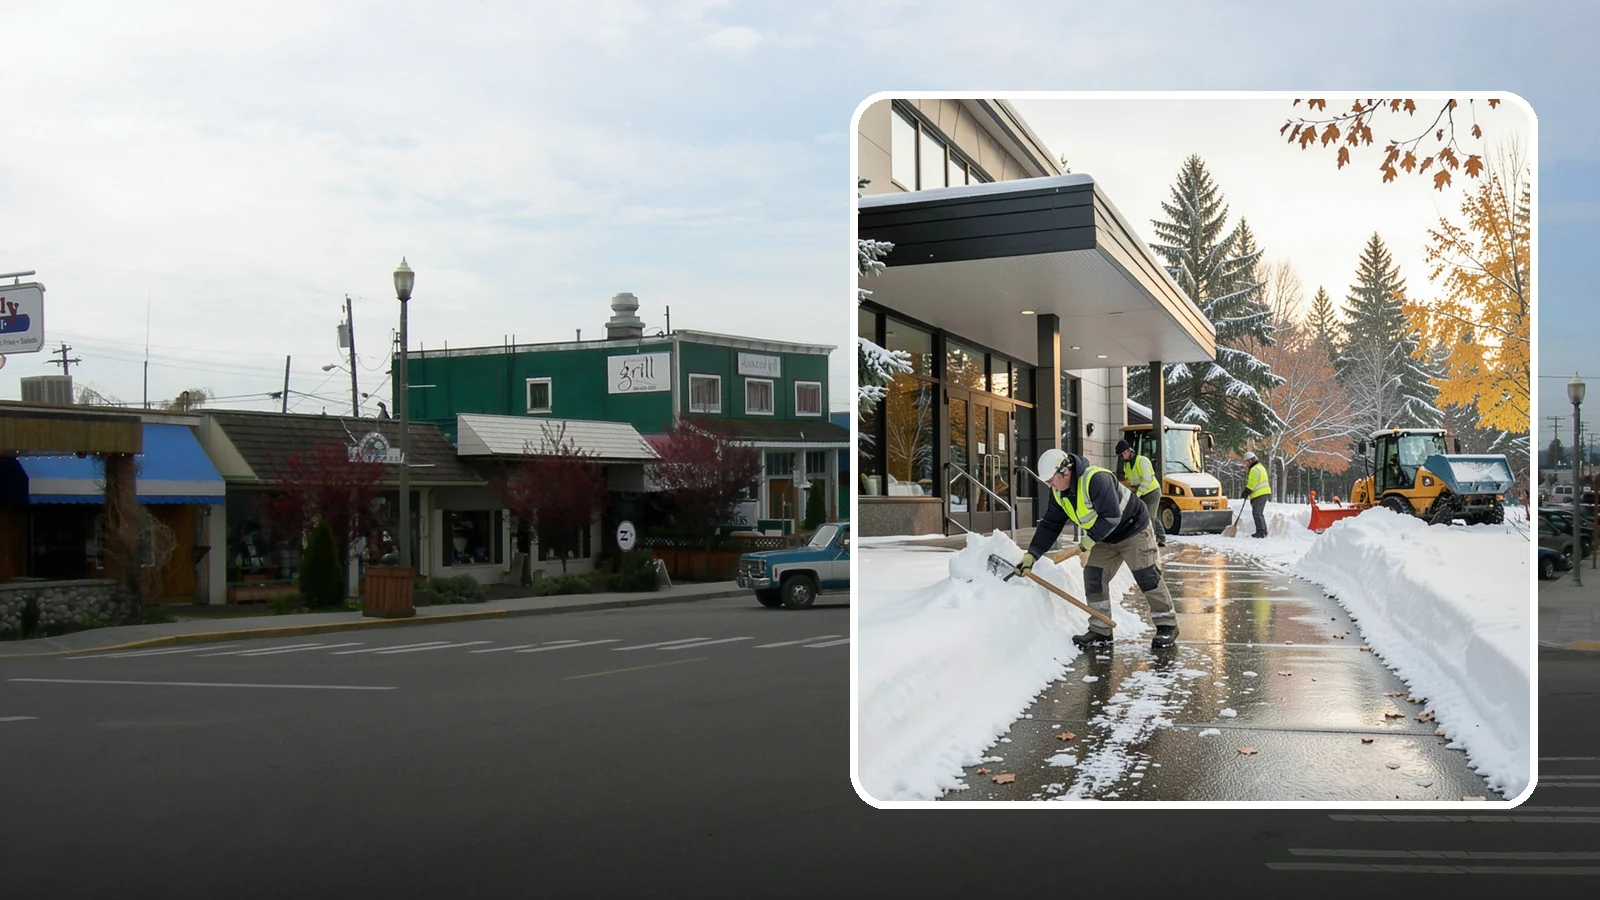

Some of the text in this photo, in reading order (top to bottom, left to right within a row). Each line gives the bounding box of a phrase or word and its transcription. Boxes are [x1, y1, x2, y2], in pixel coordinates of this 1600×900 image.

[0, 297, 19, 324] ly
[20, 337, 38, 345] Salads
[617, 356, 654, 391] grill
